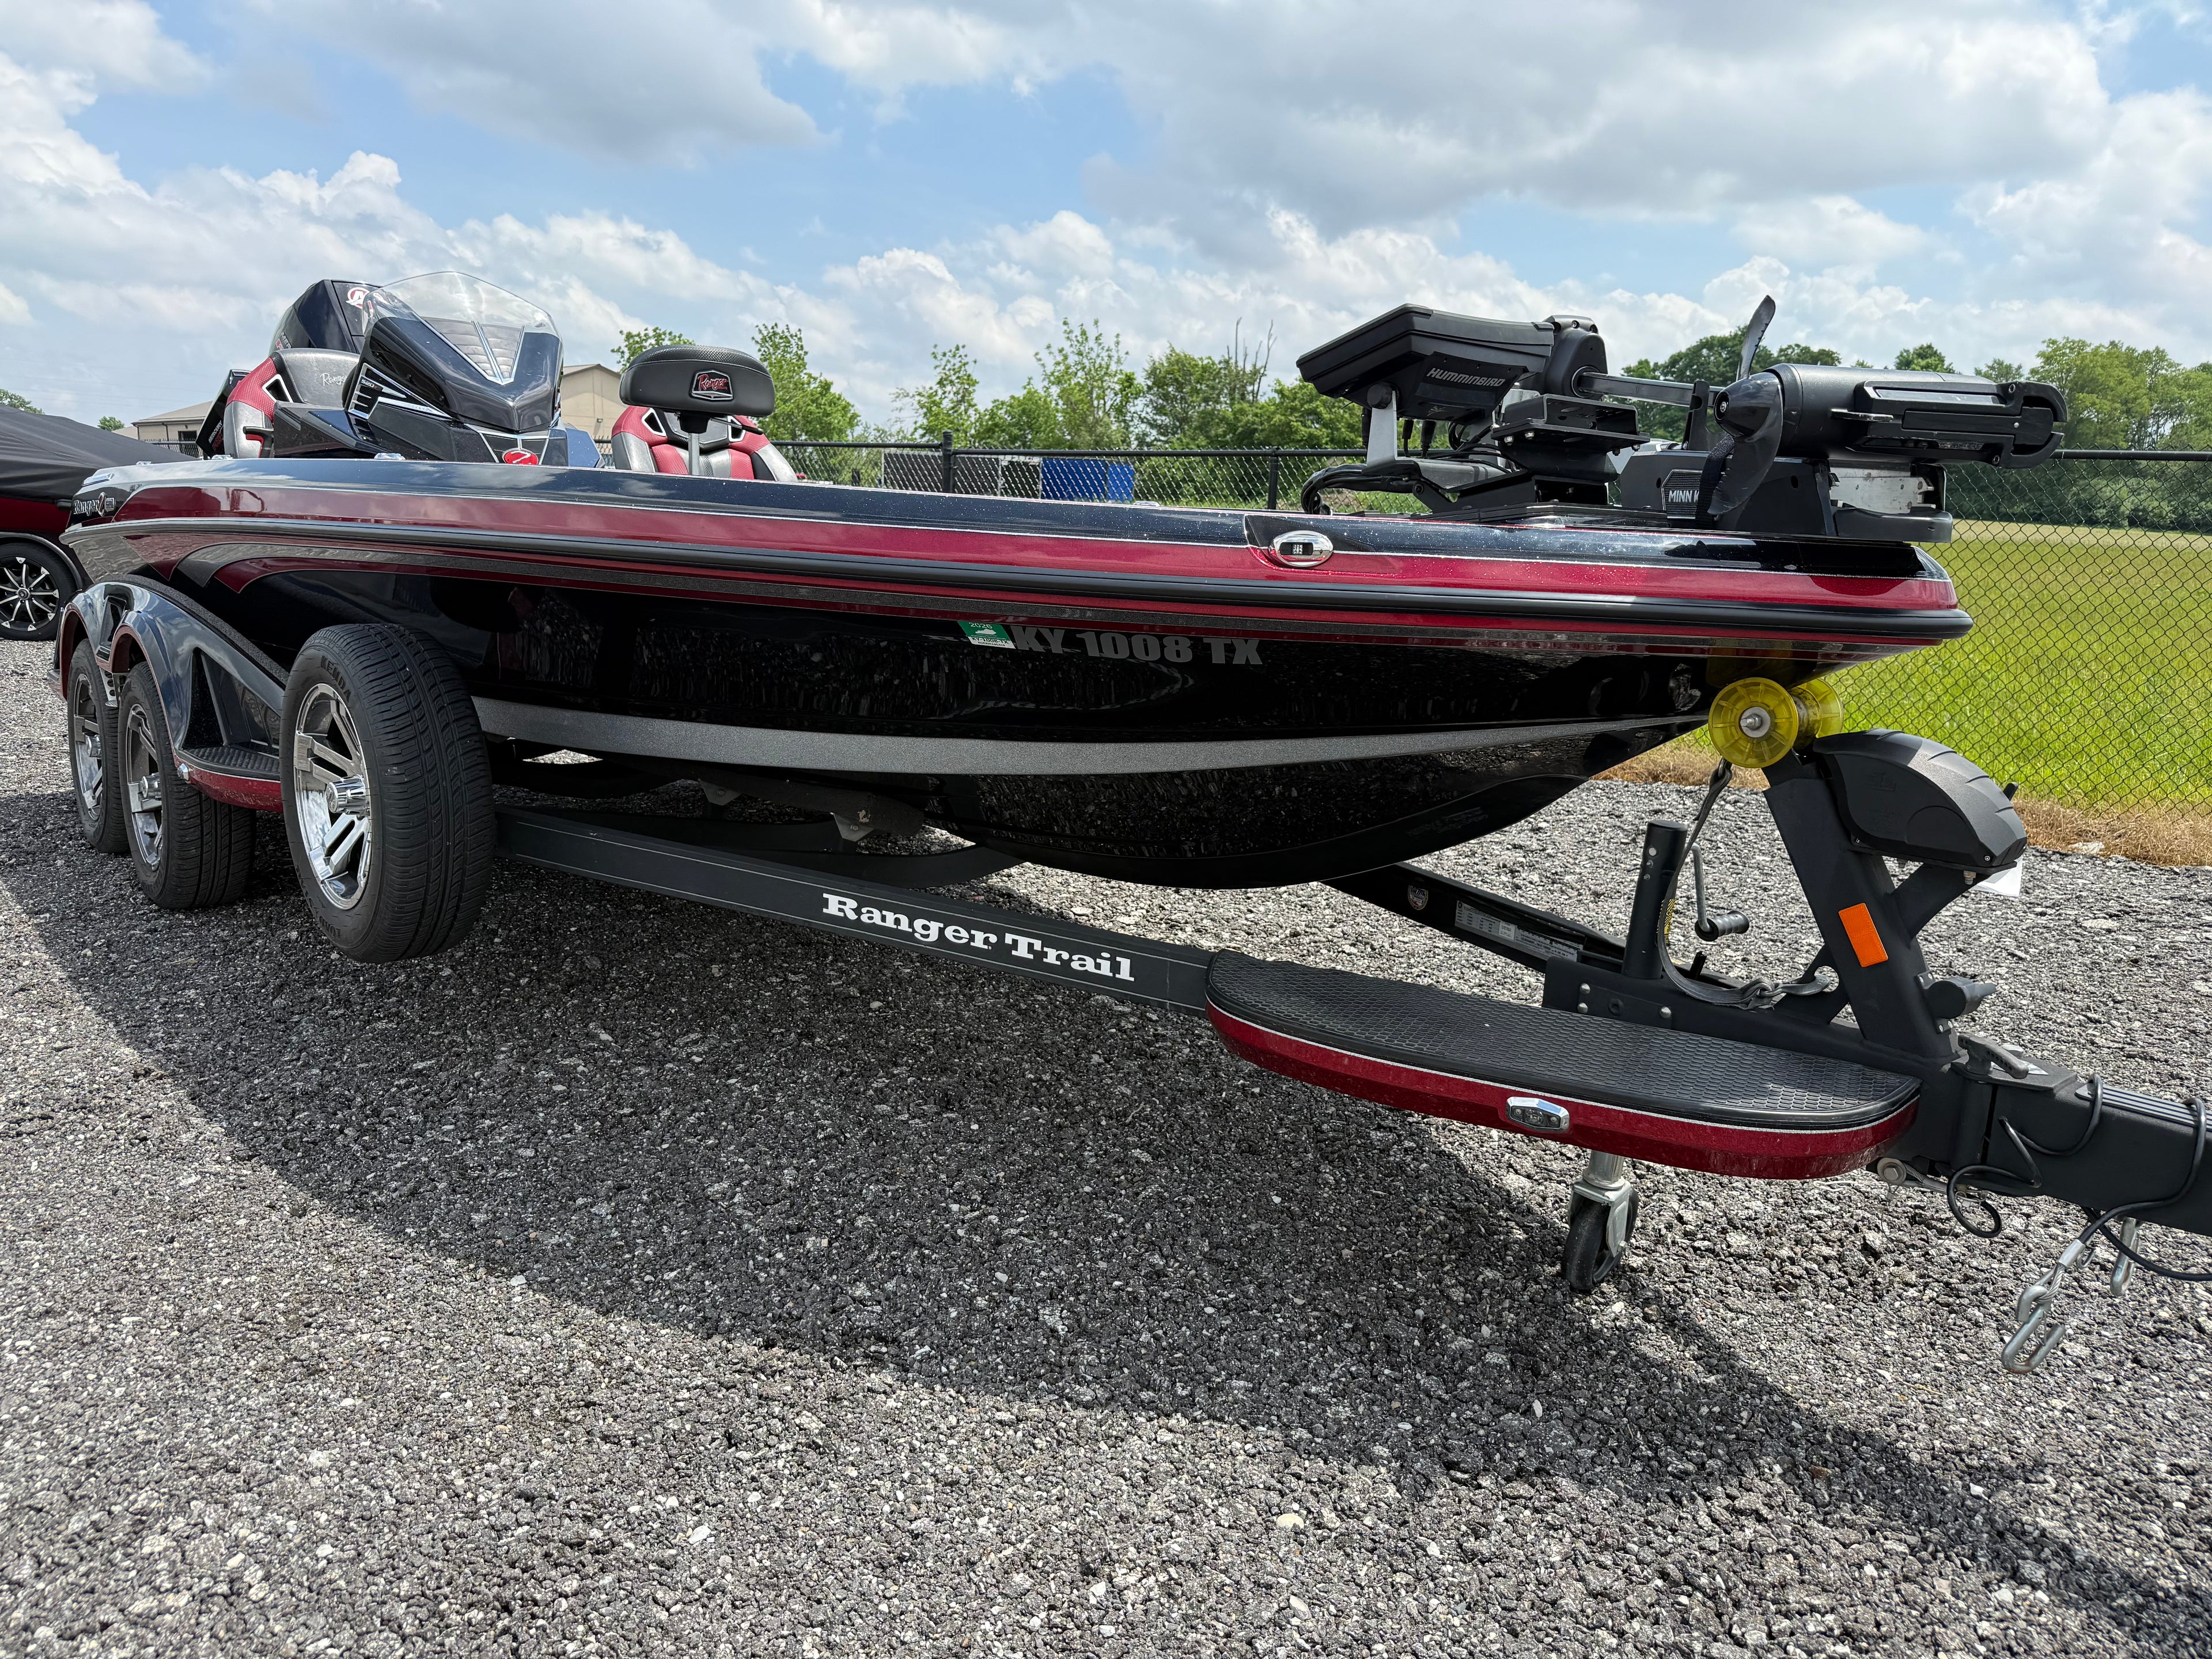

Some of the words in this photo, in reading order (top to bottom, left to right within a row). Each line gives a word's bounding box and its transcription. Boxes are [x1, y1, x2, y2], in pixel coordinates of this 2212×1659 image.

[697, 374, 728, 391] Ranger
[1426, 368, 1506, 387] HUMMINBIRD
[1668, 490, 1693, 502] MINN
[1010, 625, 1065, 654] KY
[1076, 631, 1193, 662] 1008
[1202, 638, 1263, 665] TX
[320, 656, 351, 702] KENDA
[823, 893, 998, 950] Ranger
[1005, 933, 1135, 982] Trail
